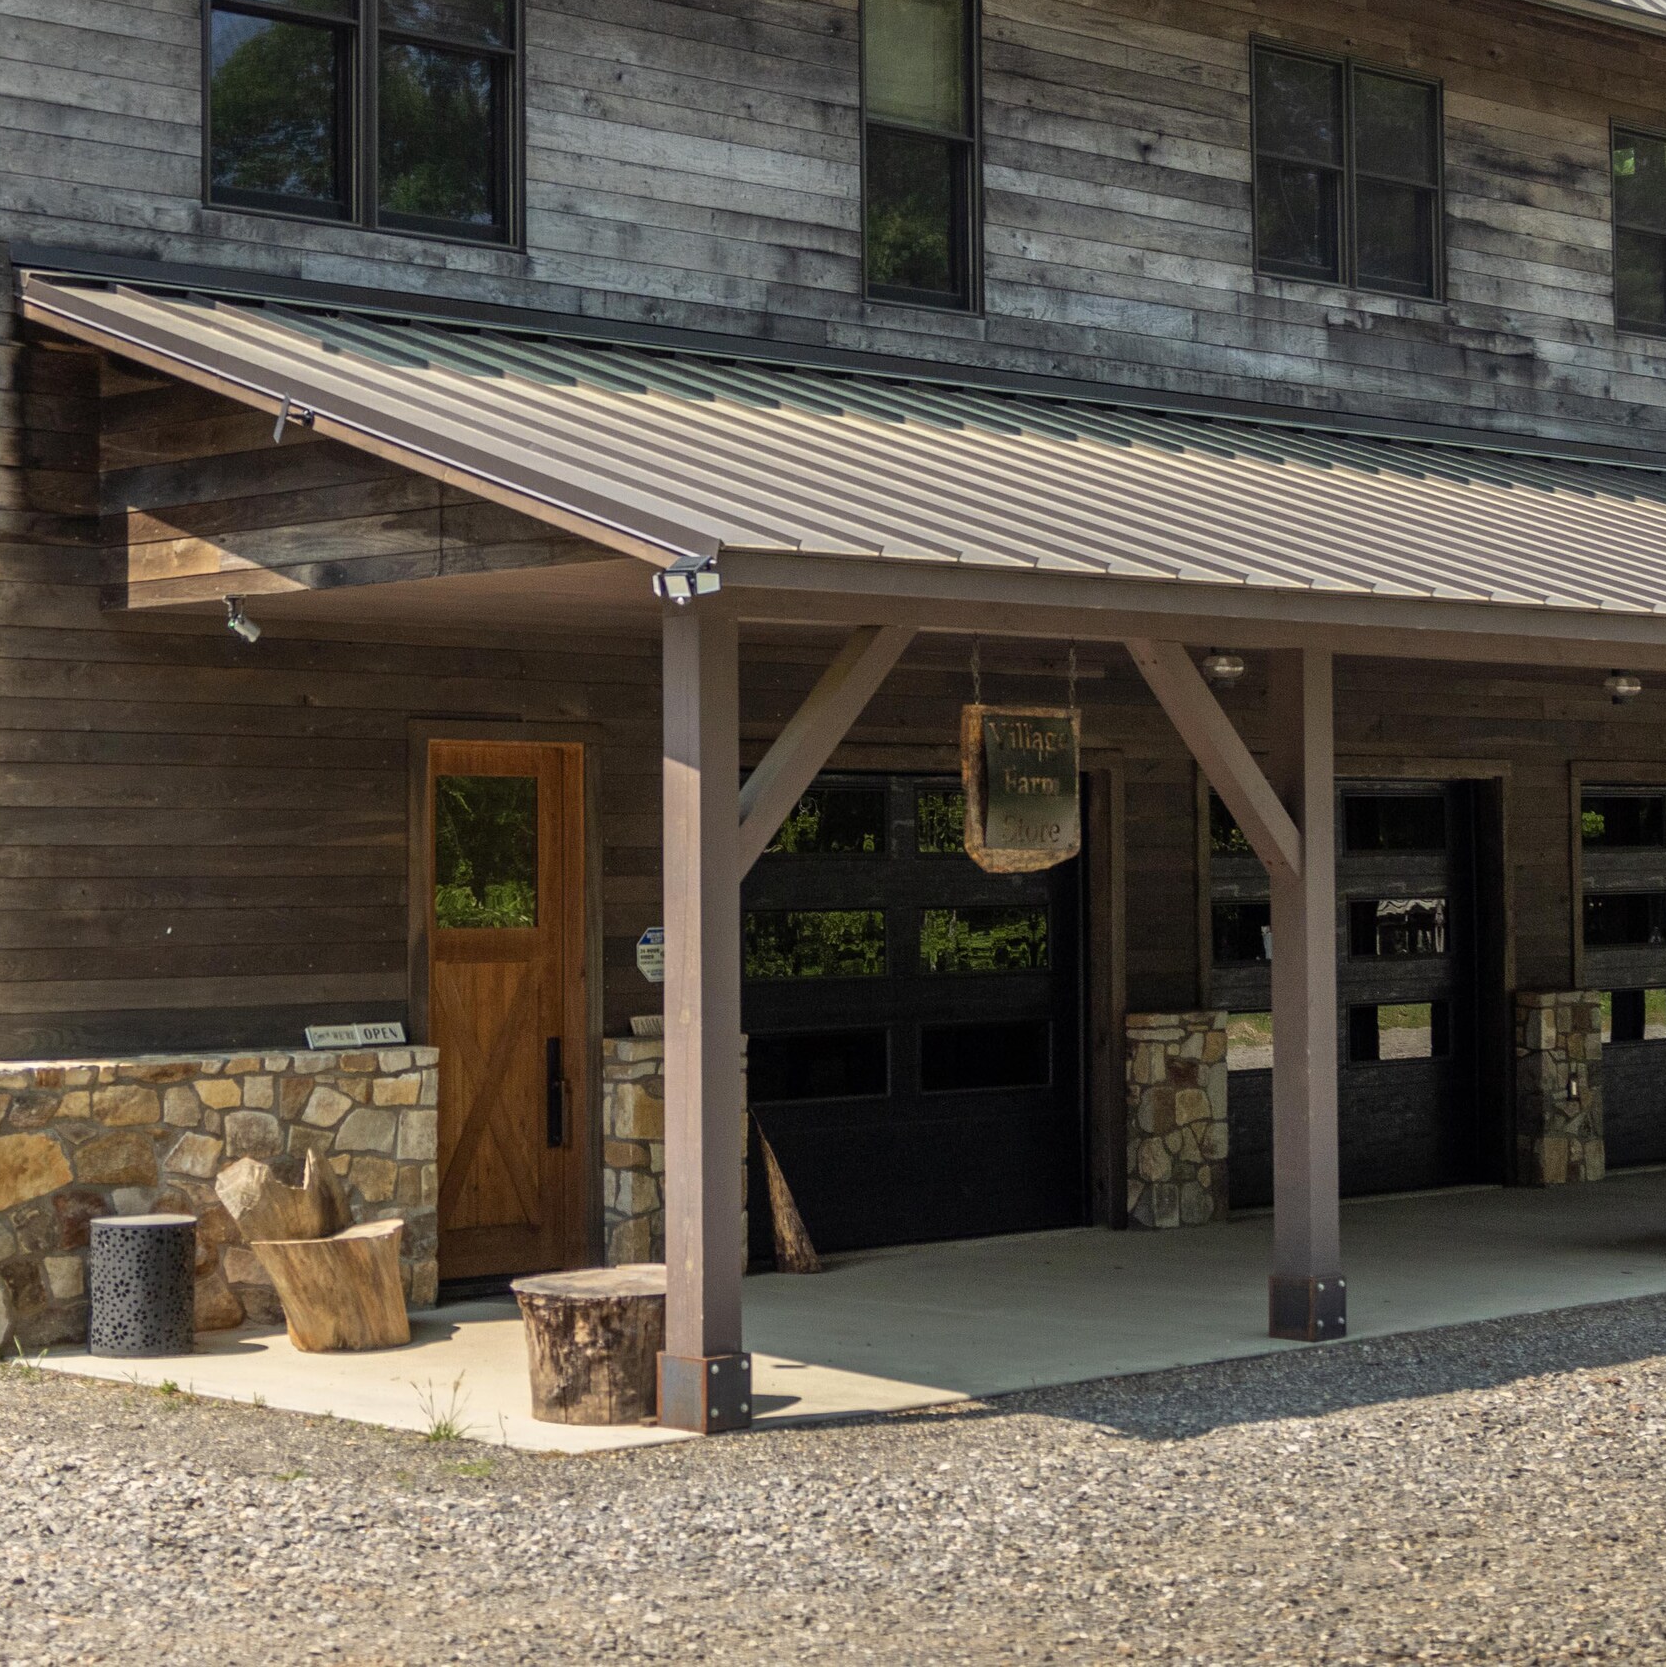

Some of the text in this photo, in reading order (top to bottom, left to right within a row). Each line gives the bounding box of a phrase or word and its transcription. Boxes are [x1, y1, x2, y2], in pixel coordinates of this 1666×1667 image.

[988, 722, 1068, 759] Village
[1004, 768, 1060, 794] Farm
[1002, 814, 1061, 844] Store
[363, 1027, 399, 1040] OPEN
